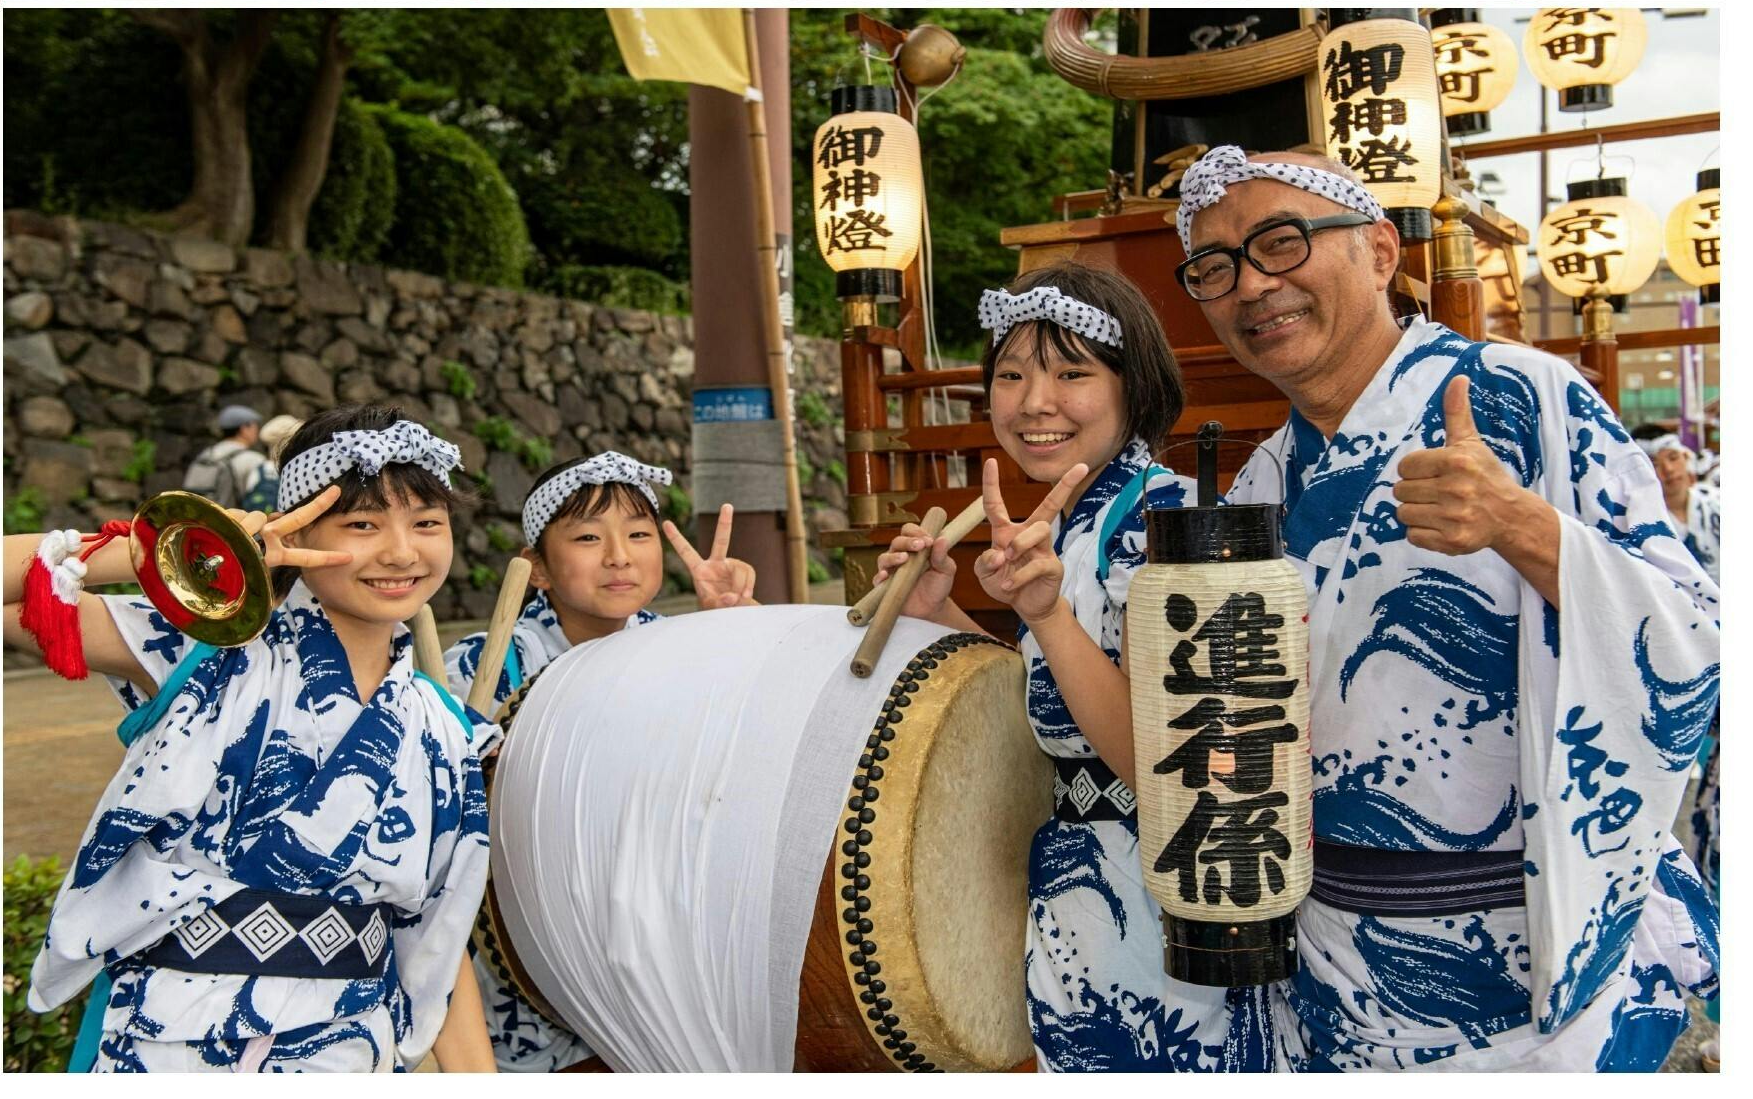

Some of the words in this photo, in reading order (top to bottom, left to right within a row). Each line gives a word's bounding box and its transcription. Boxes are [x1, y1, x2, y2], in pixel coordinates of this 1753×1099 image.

[817, 125, 894, 256] 御神燈
[1549, 208, 1624, 284] 京町
[1153, 591, 1300, 908] 進行係
